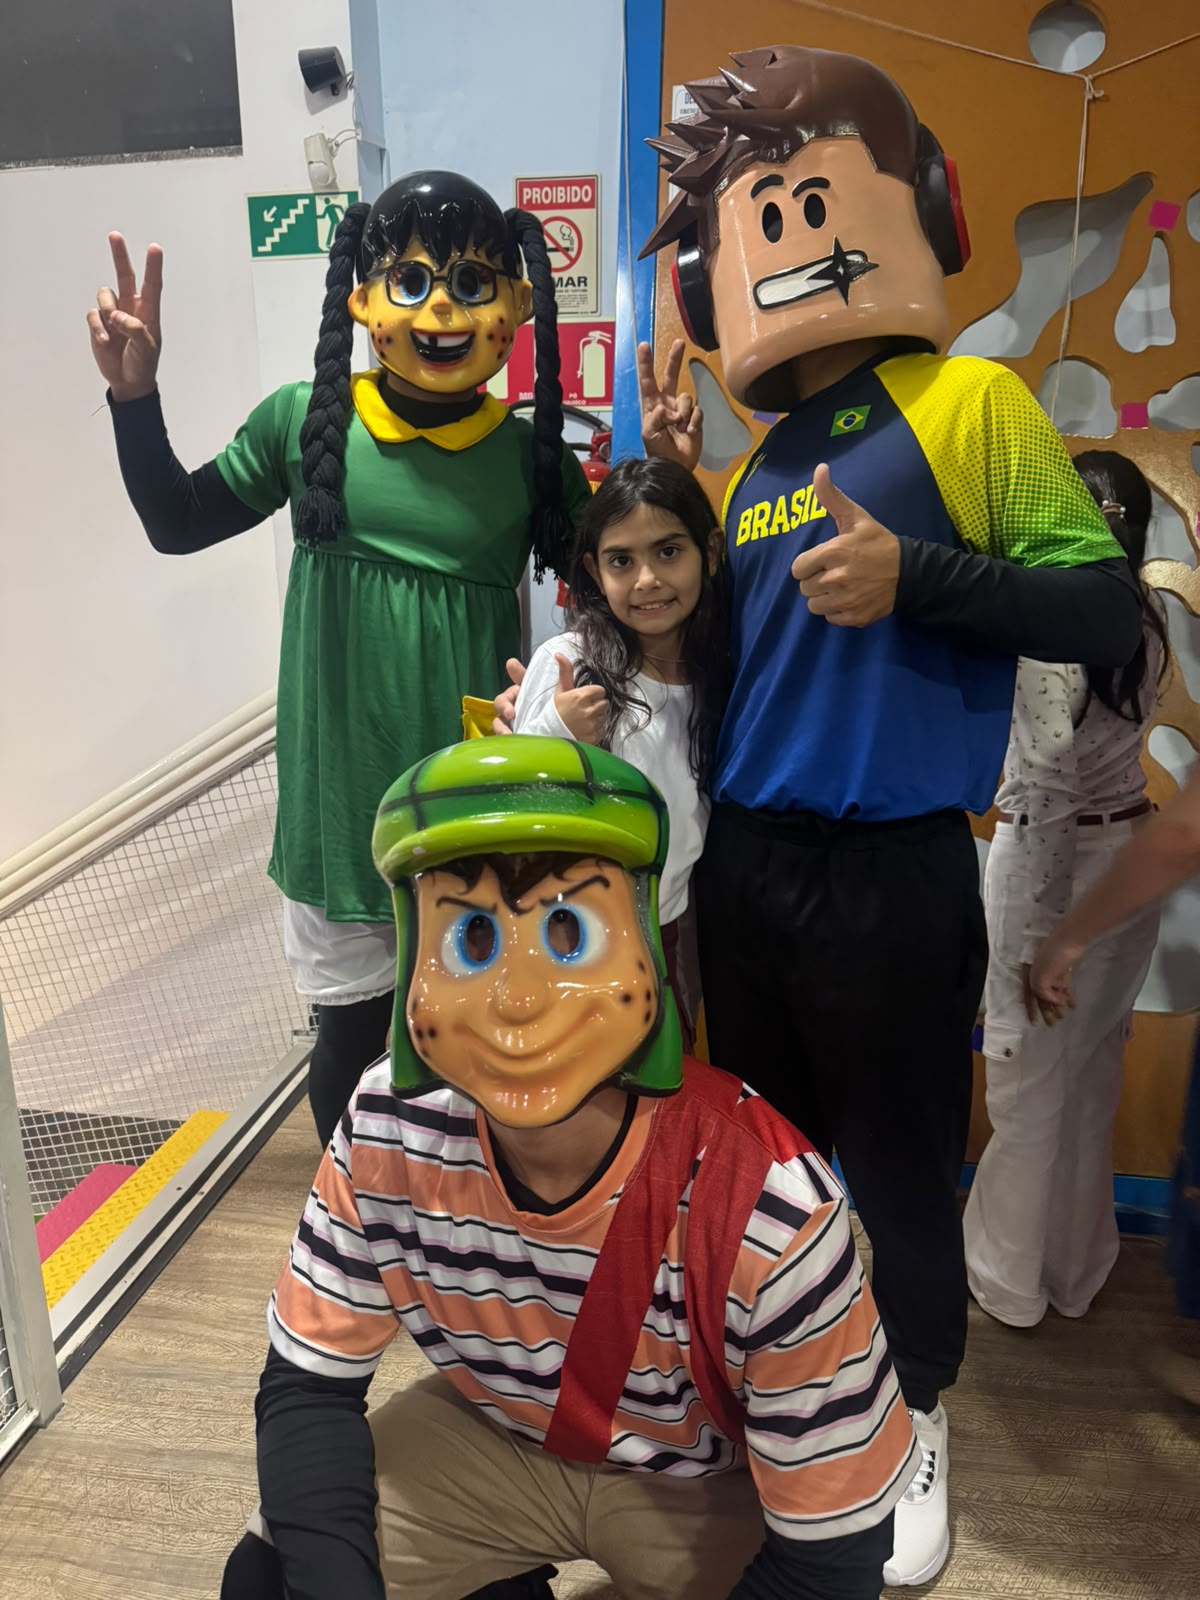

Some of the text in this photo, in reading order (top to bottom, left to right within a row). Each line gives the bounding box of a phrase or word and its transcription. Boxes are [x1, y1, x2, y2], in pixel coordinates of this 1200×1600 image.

[522, 185, 592, 205] PROIBIDO
[552, 276, 588, 288] MAR
[736, 484, 827, 547] BRASIL
